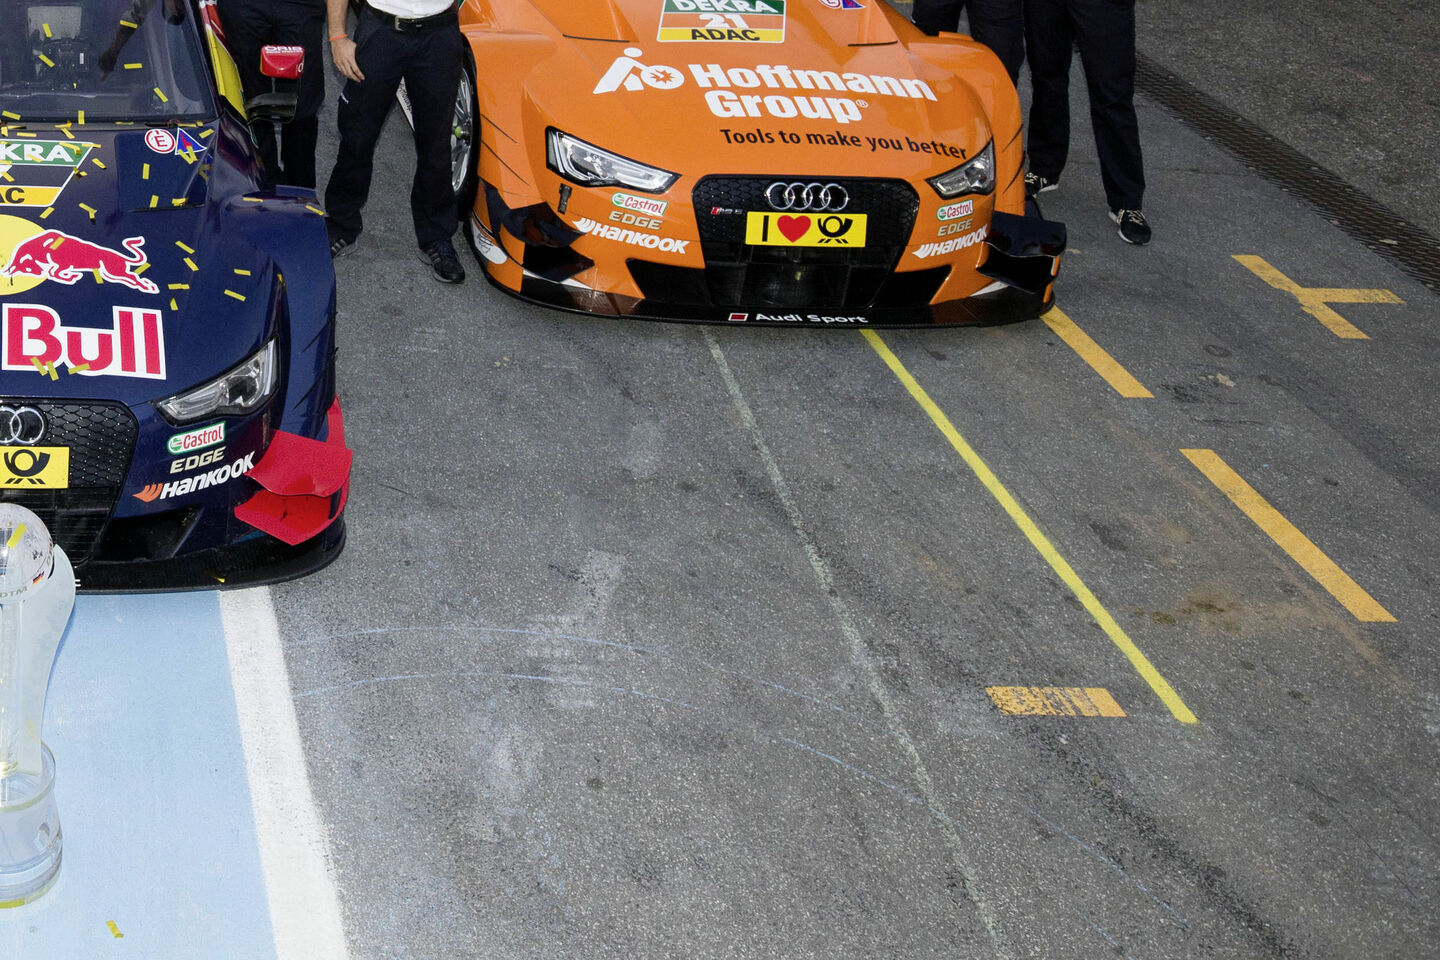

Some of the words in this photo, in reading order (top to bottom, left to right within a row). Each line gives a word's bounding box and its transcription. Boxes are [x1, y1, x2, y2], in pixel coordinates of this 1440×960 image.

[699, 14, 750, 28] 21
[690, 28, 760, 42] ADAC
[688, 63, 938, 102] Hoffmann
[720, 128, 775, 145] Tools
[778, 131, 801, 145] to
[806, 130, 862, 149] make
[865, 135, 902, 153] you
[904, 135, 968, 160] better
[624, 196, 664, 215] Castrol
[946, 201, 972, 218] Castrol
[609, 210, 664, 230] EDGE
[937, 218, 973, 237] EDGE
[755, 312, 806, 323] Audi
[808, 313, 869, 325] Sport
[1, 302, 166, 380] Bull
[183, 425, 223, 449] Castrol
[170, 446, 226, 474] EDGE
[0, 586, 28, 599] DTM
